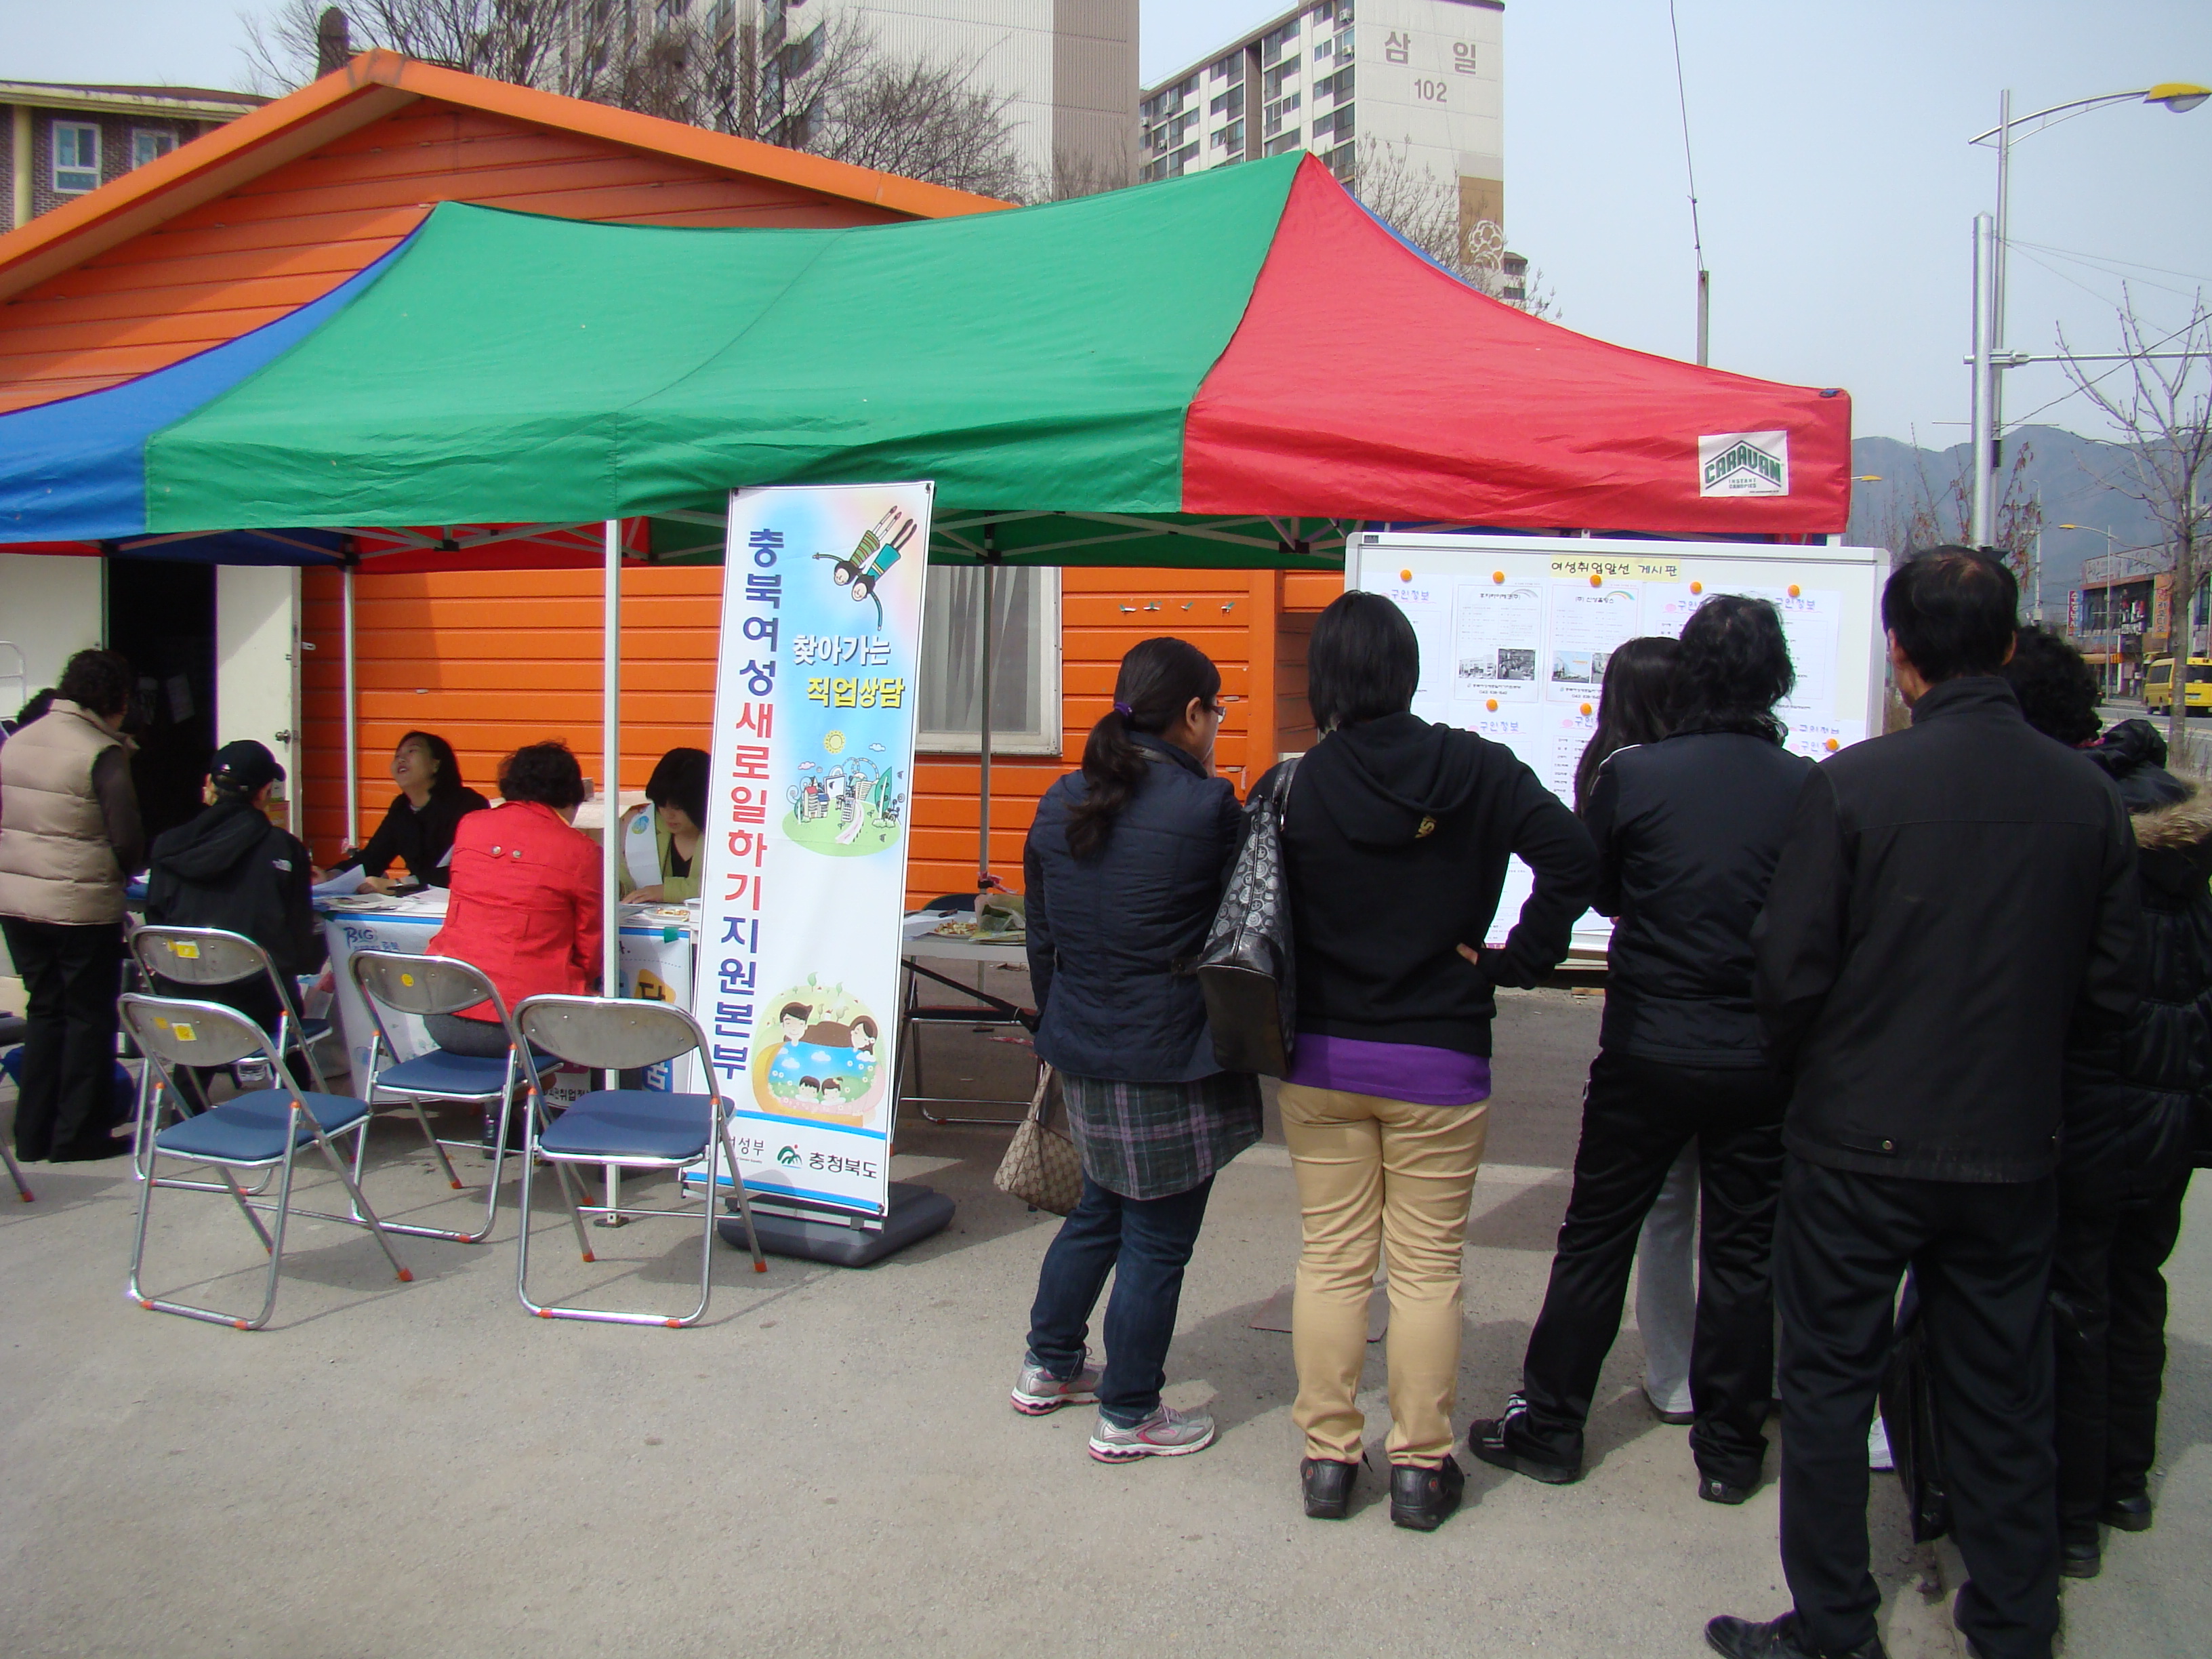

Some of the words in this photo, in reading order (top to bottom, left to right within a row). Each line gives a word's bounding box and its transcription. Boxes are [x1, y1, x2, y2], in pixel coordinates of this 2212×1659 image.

[1414, 79, 1448, 103] 102
[1704, 445, 1781, 484] CARAVAN
[1551, 561, 1630, 575] 여성취업알선
[1638, 565, 1677, 577] 게시판
[1391, 589, 1429, 601] 구인정보
[1677, 600, 1697, 611] 구인
[792, 634, 890, 665] 찾아가는
[807, 677, 905, 708] 직업상담
[1480, 721, 1519, 731] 구인정보
[1575, 716, 1593, 727] 구인
[343, 926, 374, 949] BIG
[809, 1152, 878, 1179] 충청북도
